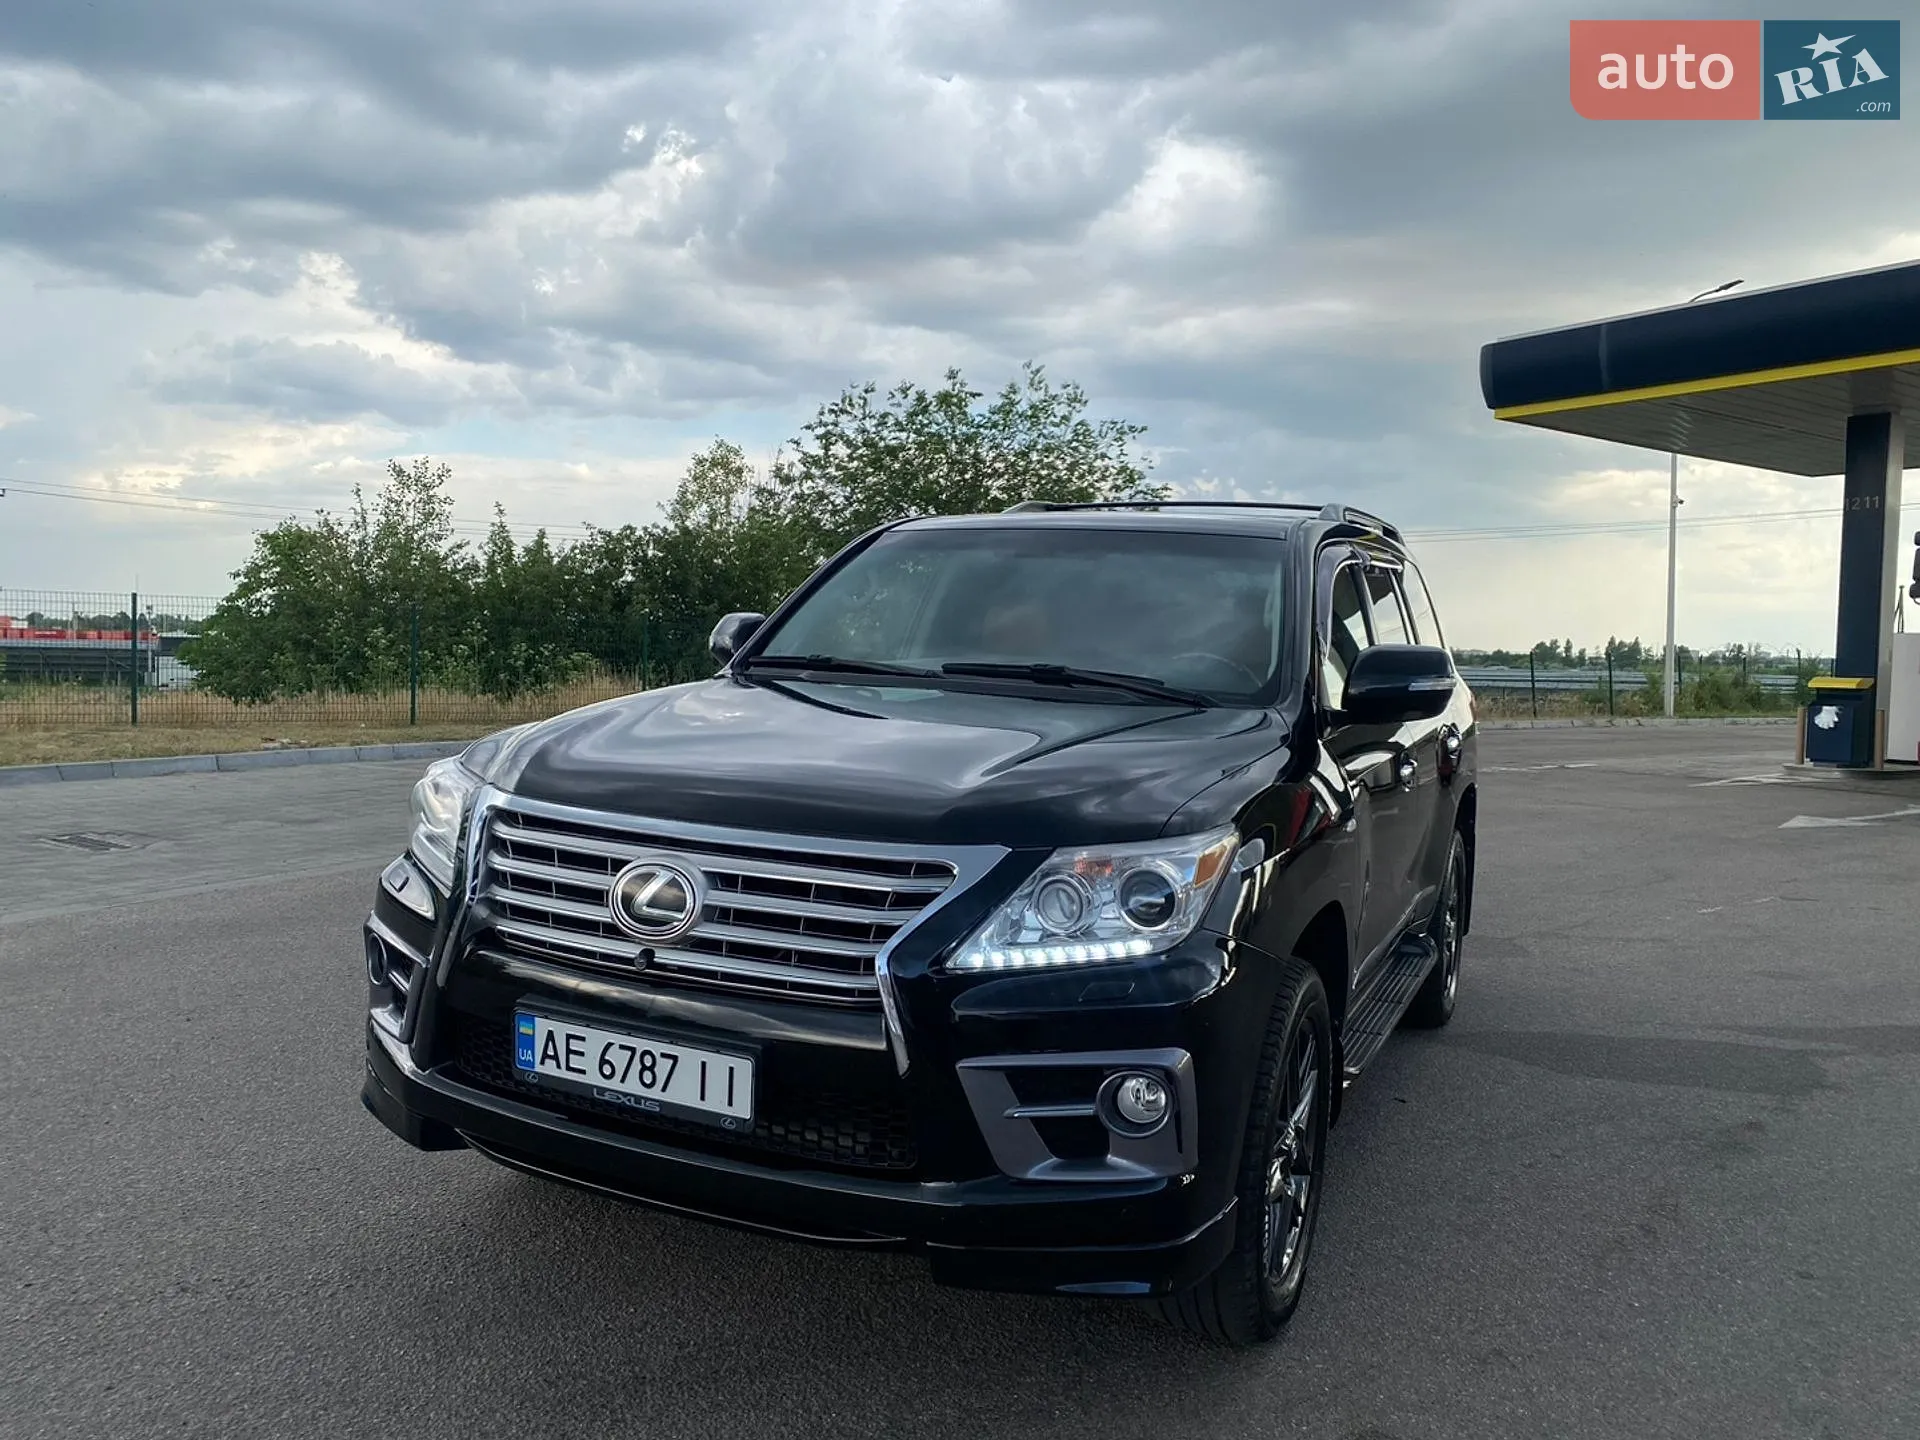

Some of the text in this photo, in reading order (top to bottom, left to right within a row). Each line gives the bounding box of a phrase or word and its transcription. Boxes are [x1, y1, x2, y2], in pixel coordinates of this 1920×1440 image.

[518, 1047, 534, 1063] UA
[539, 1029, 587, 1075] AE
[598, 1042, 679, 1093] 6787
[592, 1087, 661, 1113] LEXUS
